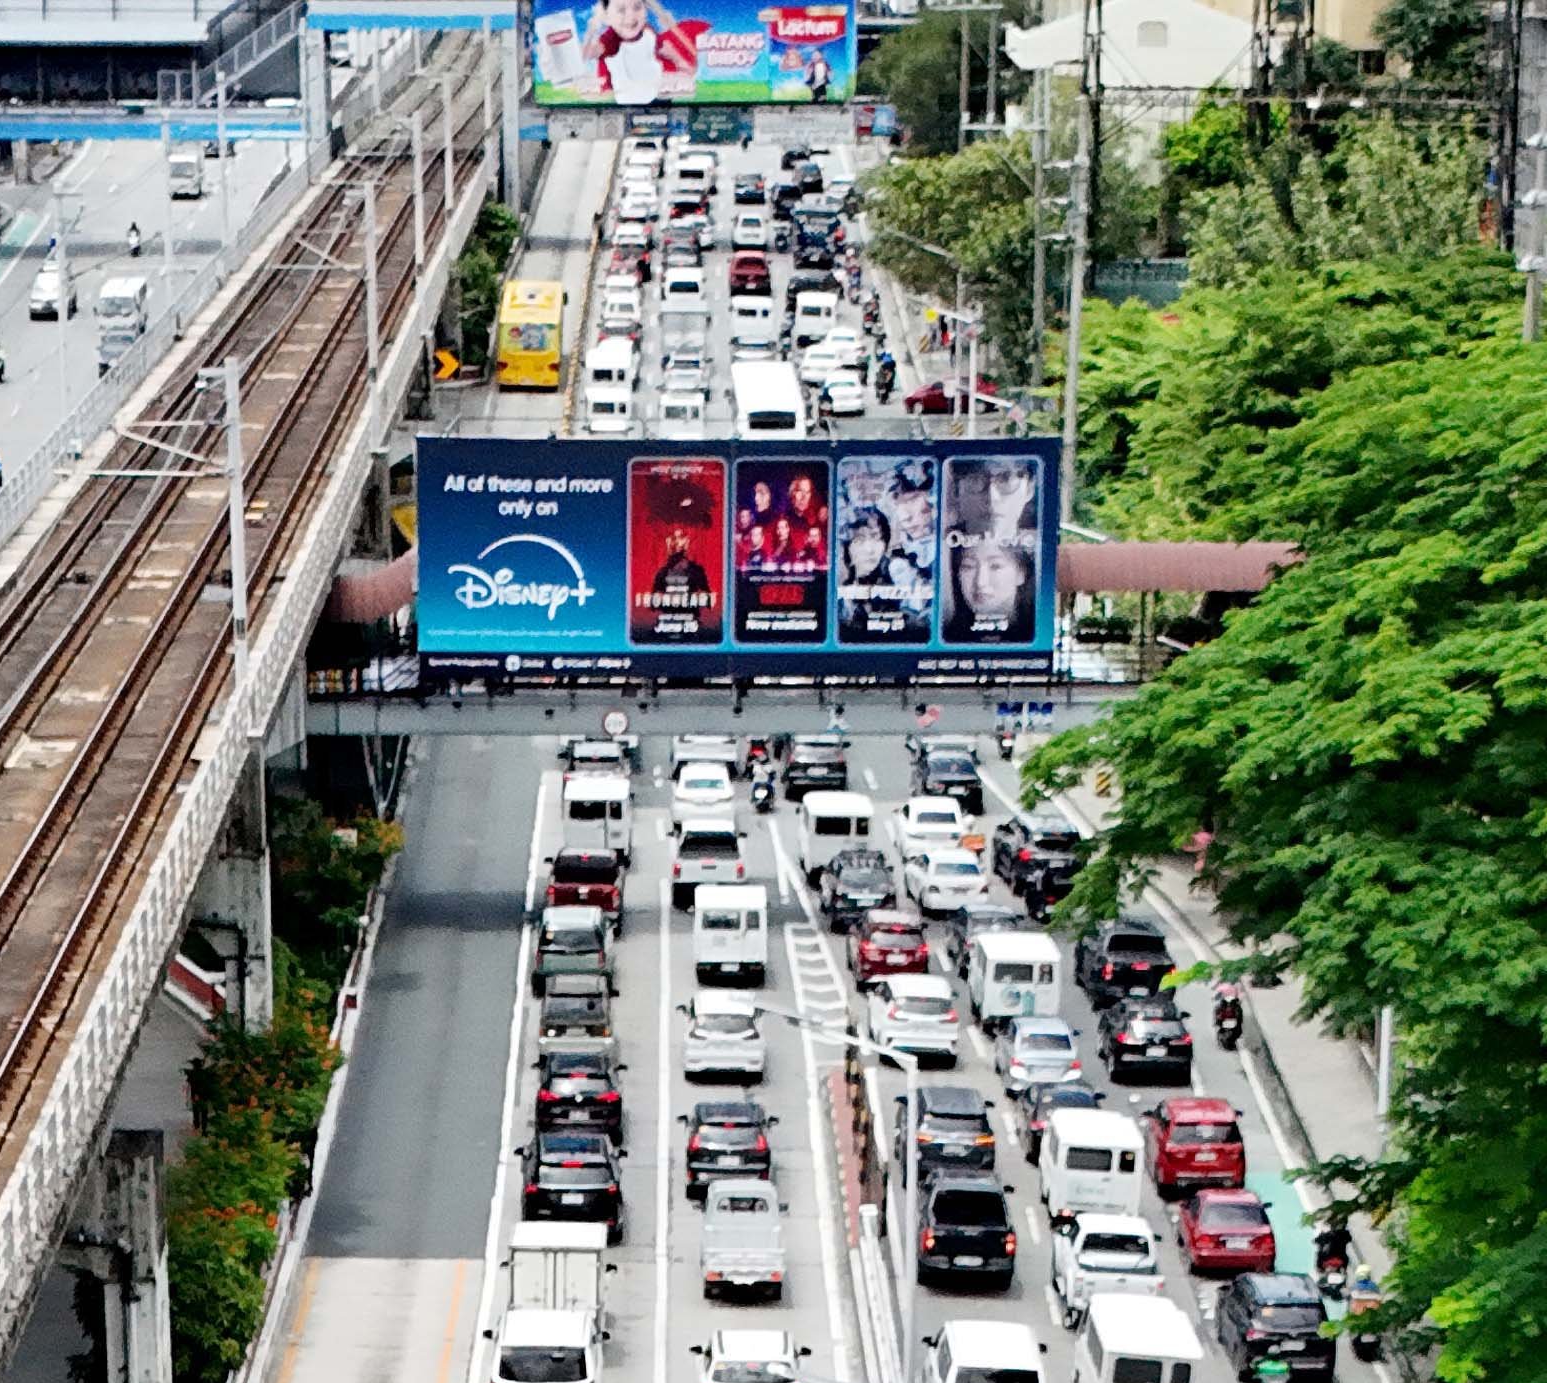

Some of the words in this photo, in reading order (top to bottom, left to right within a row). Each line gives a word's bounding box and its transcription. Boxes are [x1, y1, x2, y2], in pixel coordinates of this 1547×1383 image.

[778, 19, 838, 36] Lactum
[443, 475, 465, 492] All
[467, 475, 485, 492] of
[487, 475, 532, 493] these
[535, 476, 567, 493] and
[569, 478, 614, 493] more
[499, 498, 533, 519] only
[536, 502, 558, 516] on
